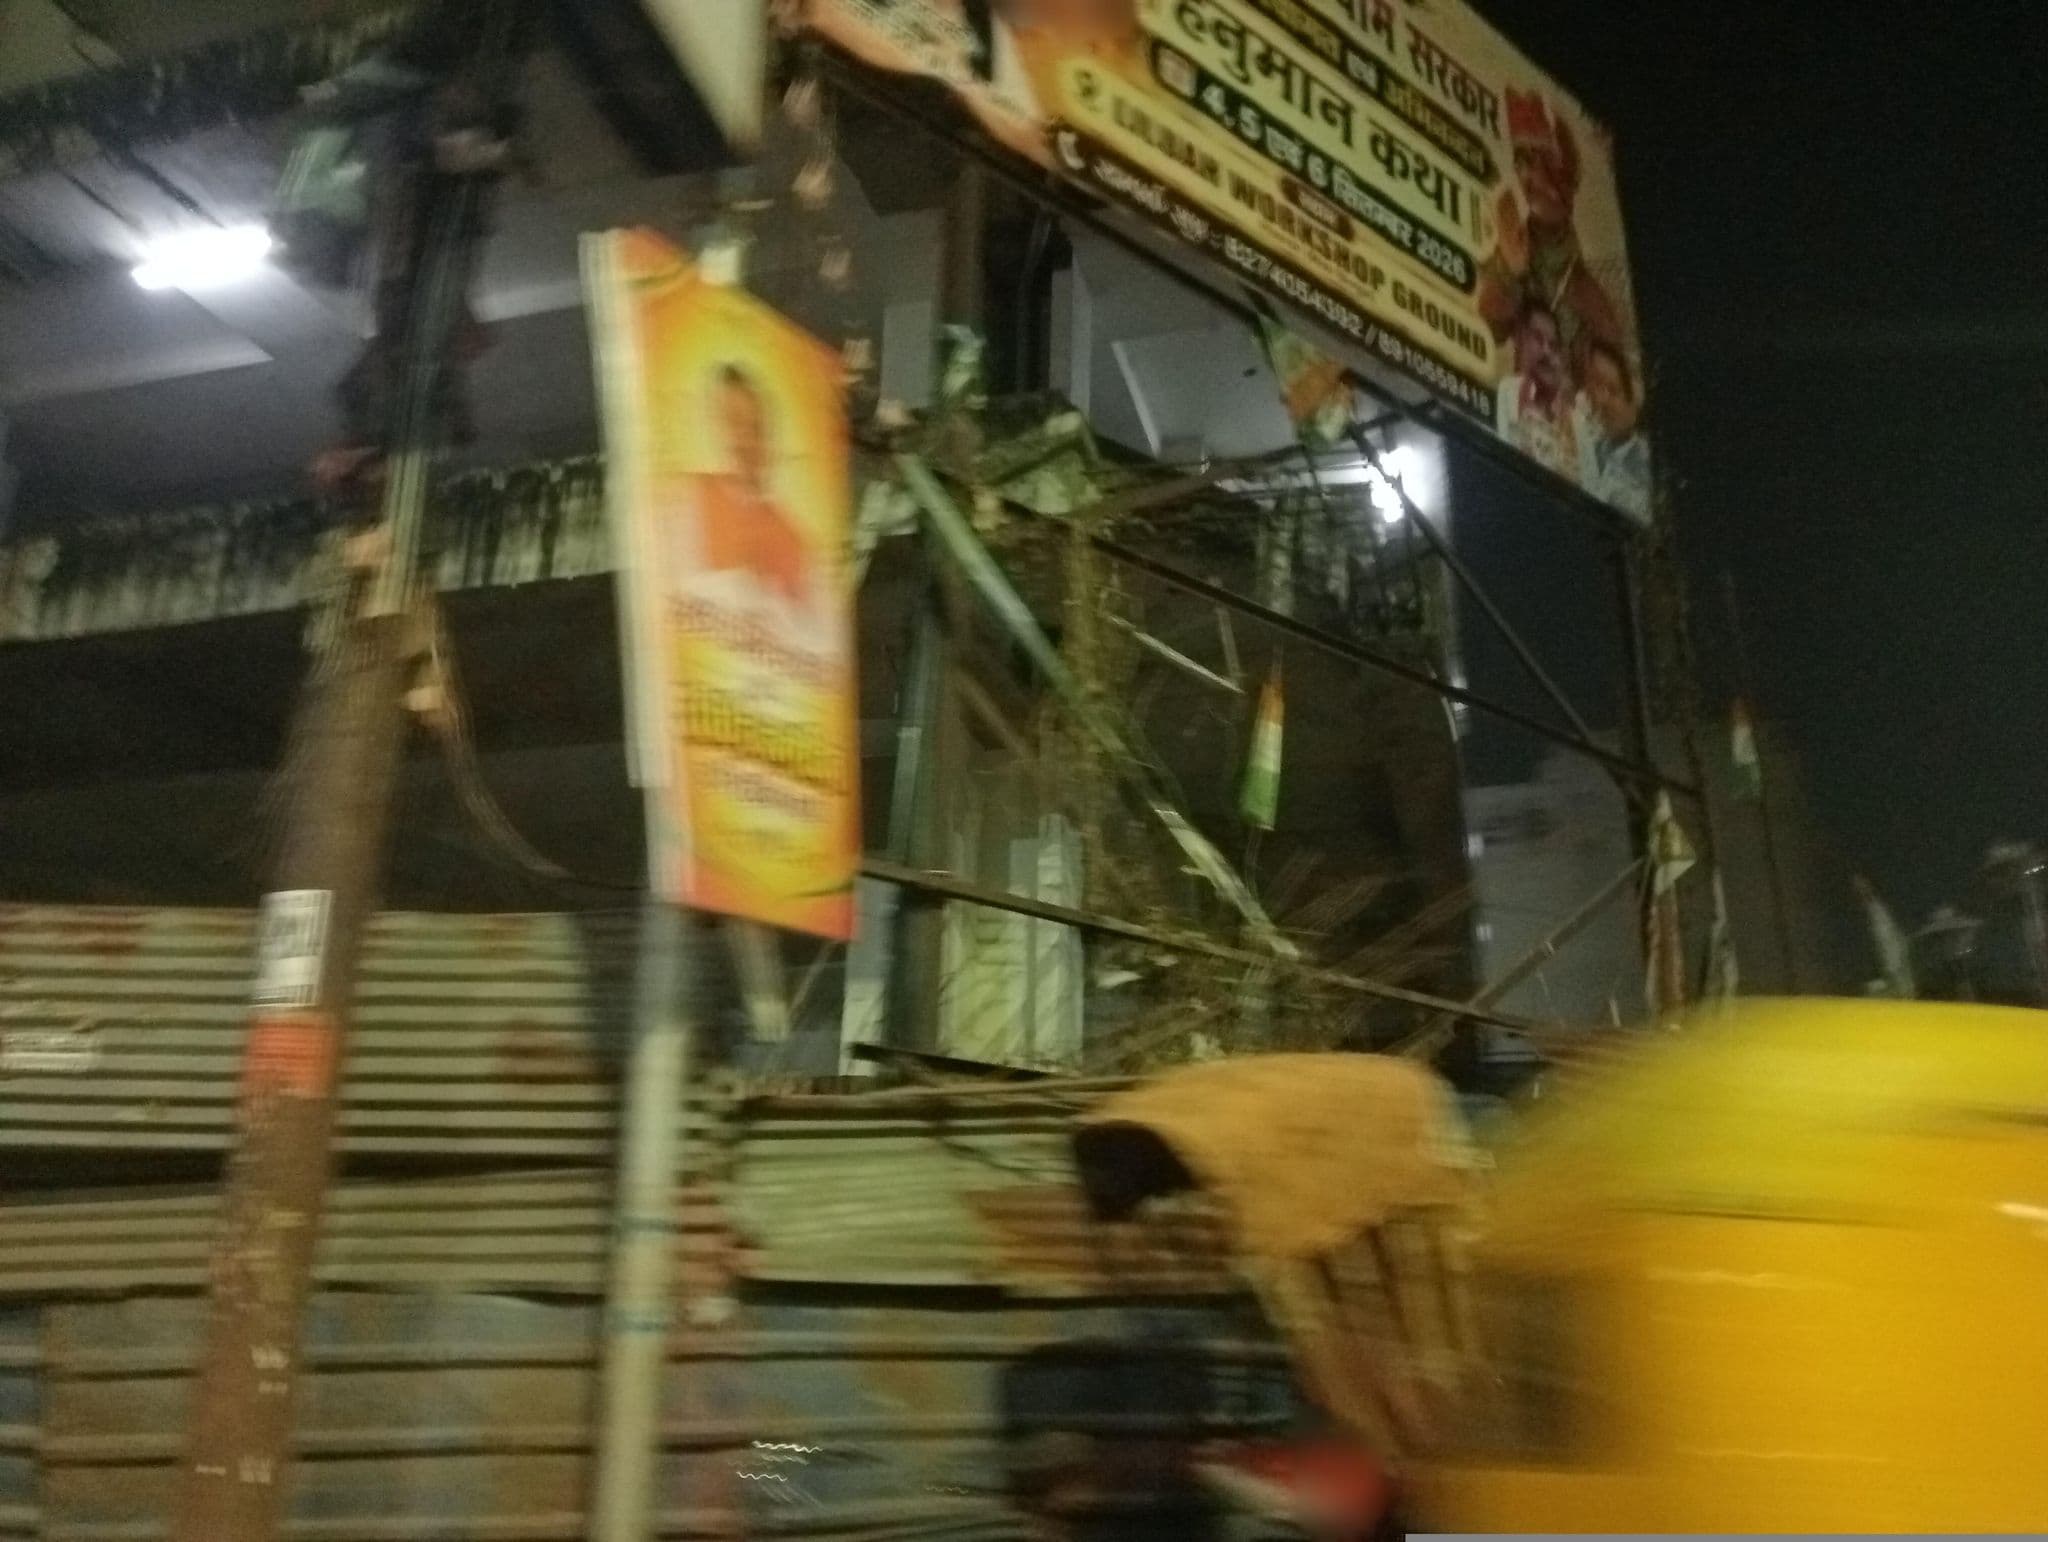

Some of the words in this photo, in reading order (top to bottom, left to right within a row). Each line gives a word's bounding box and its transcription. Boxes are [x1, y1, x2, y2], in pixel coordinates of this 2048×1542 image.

[1175, 0, 1355, 149] हनुमान
[1368, 117, 1461, 226] कथा
[1239, 102, 1264, 141] 5
[1307, 152, 1328, 188] 6
[1405, 20, 1500, 140] सरकार
[1227, 169, 1385, 291] WORKSHOP
[1392, 279, 1487, 363] GROUND
